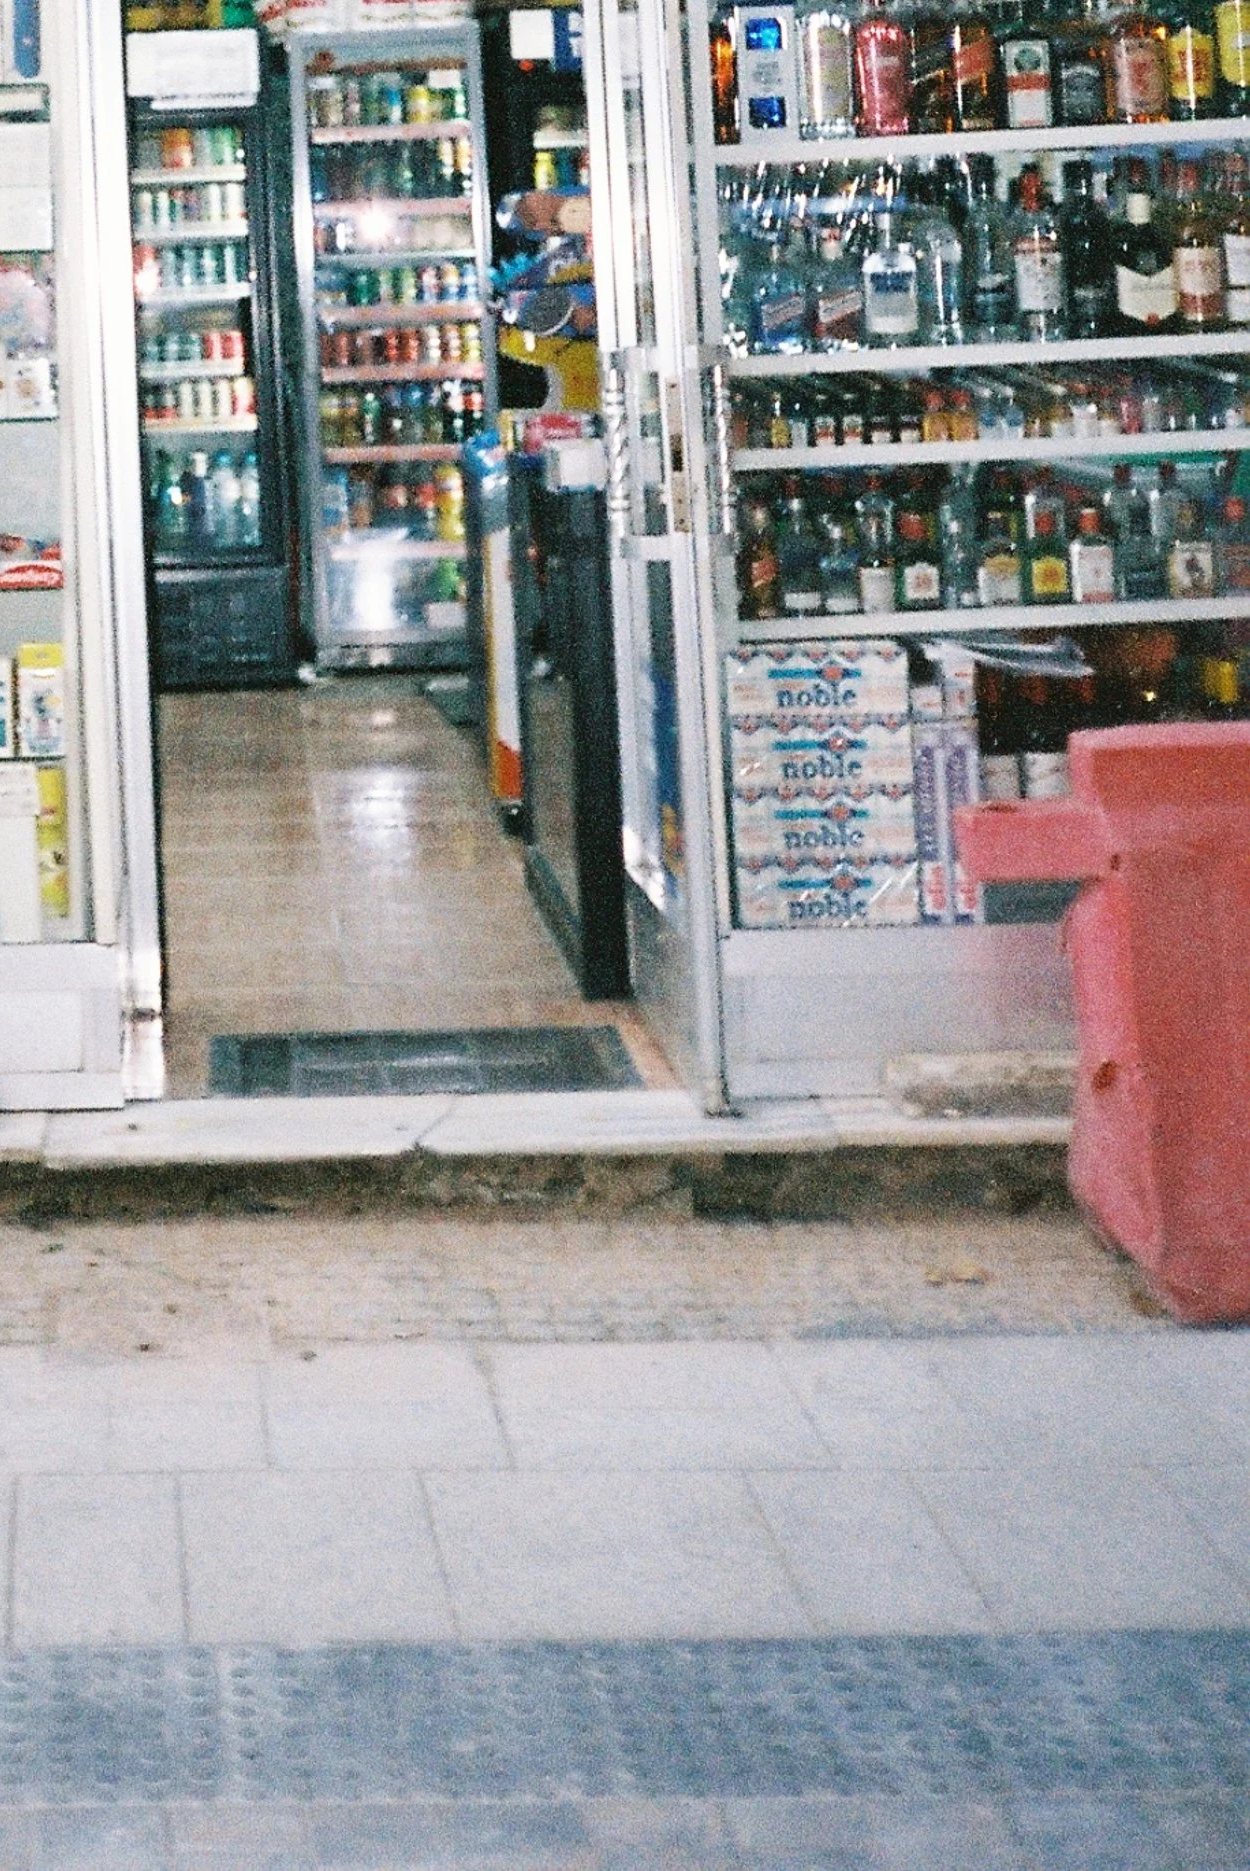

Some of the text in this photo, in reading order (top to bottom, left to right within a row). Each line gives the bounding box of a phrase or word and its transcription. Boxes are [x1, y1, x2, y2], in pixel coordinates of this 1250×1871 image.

[776, 681, 857, 708] noble
[782, 751, 863, 779] noble
[784, 821, 865, 849] noble
[788, 892, 869, 919] noble
